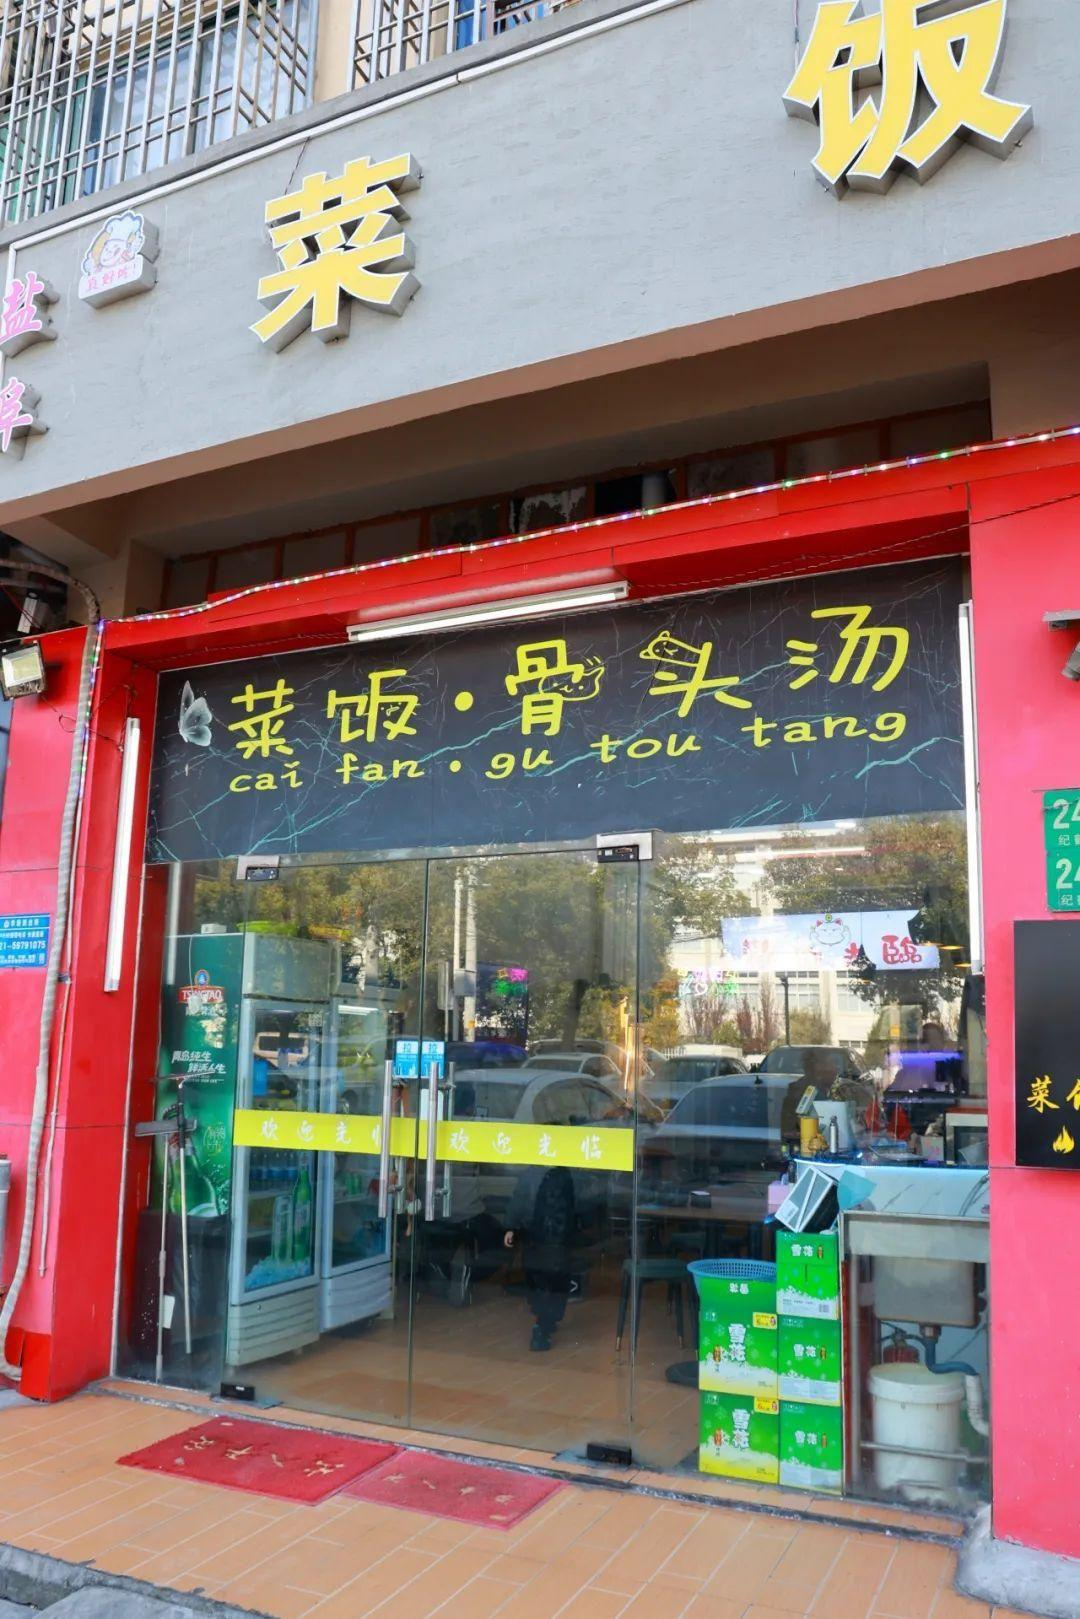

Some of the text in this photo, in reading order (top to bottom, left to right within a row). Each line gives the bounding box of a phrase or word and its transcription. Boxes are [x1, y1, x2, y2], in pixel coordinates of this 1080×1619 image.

[249, 0, 1033, 345] 菜 饭
[336, 752, 425, 785] fan
[485, 747, 554, 779] gu
[590, 733, 701, 763] tou
[741, 712, 907, 748] tang
[450, 1128, 603, 1160] 欢迎光临
[728, 1323, 747, 1361] 雪花
[732, 1408, 750, 1449] 雪花
